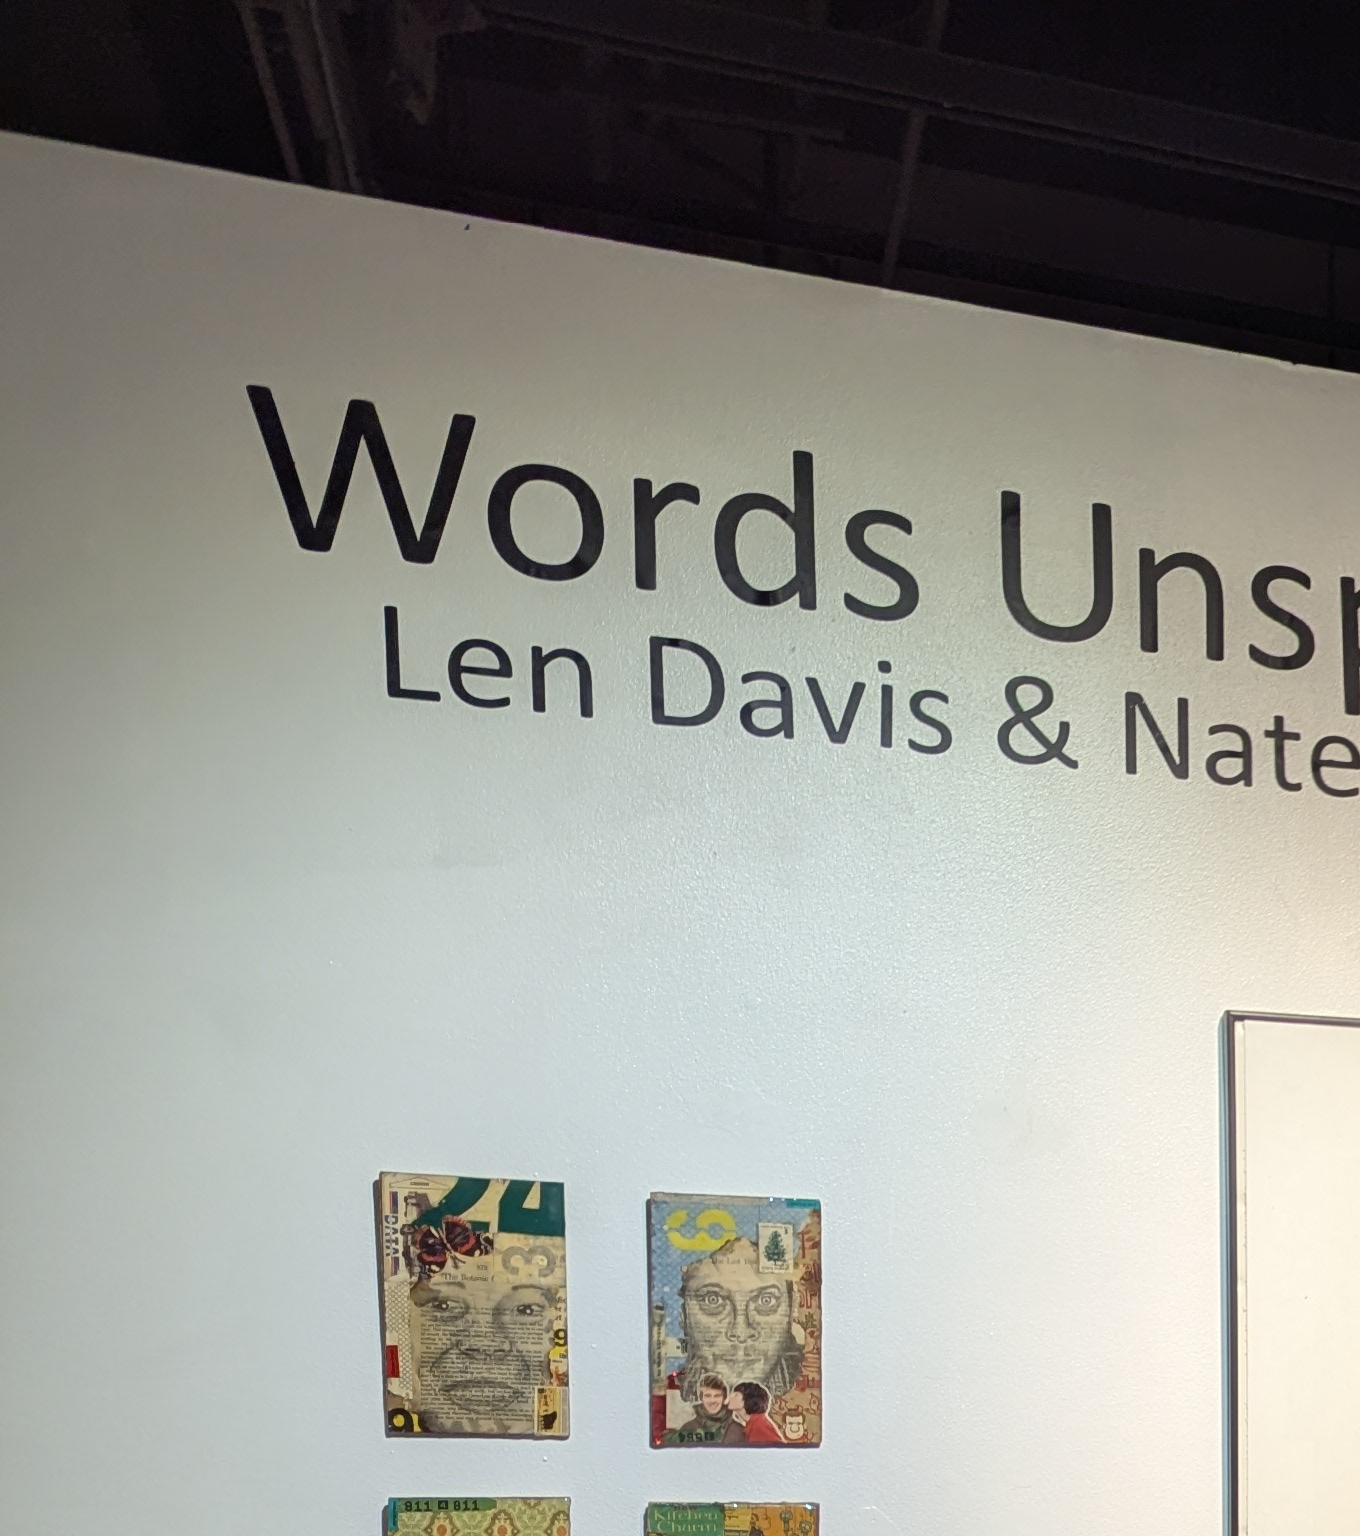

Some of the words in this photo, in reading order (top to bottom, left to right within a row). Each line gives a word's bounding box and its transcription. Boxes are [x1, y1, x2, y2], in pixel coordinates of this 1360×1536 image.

[246, 384, 920, 621] Words
[384, 605, 594, 719] Len
[648, 635, 953, 755] Davis
[997, 676, 1079, 770] &
[404, 1500, 433, 1512] 811
[453, 1500, 480, 1511] 811
